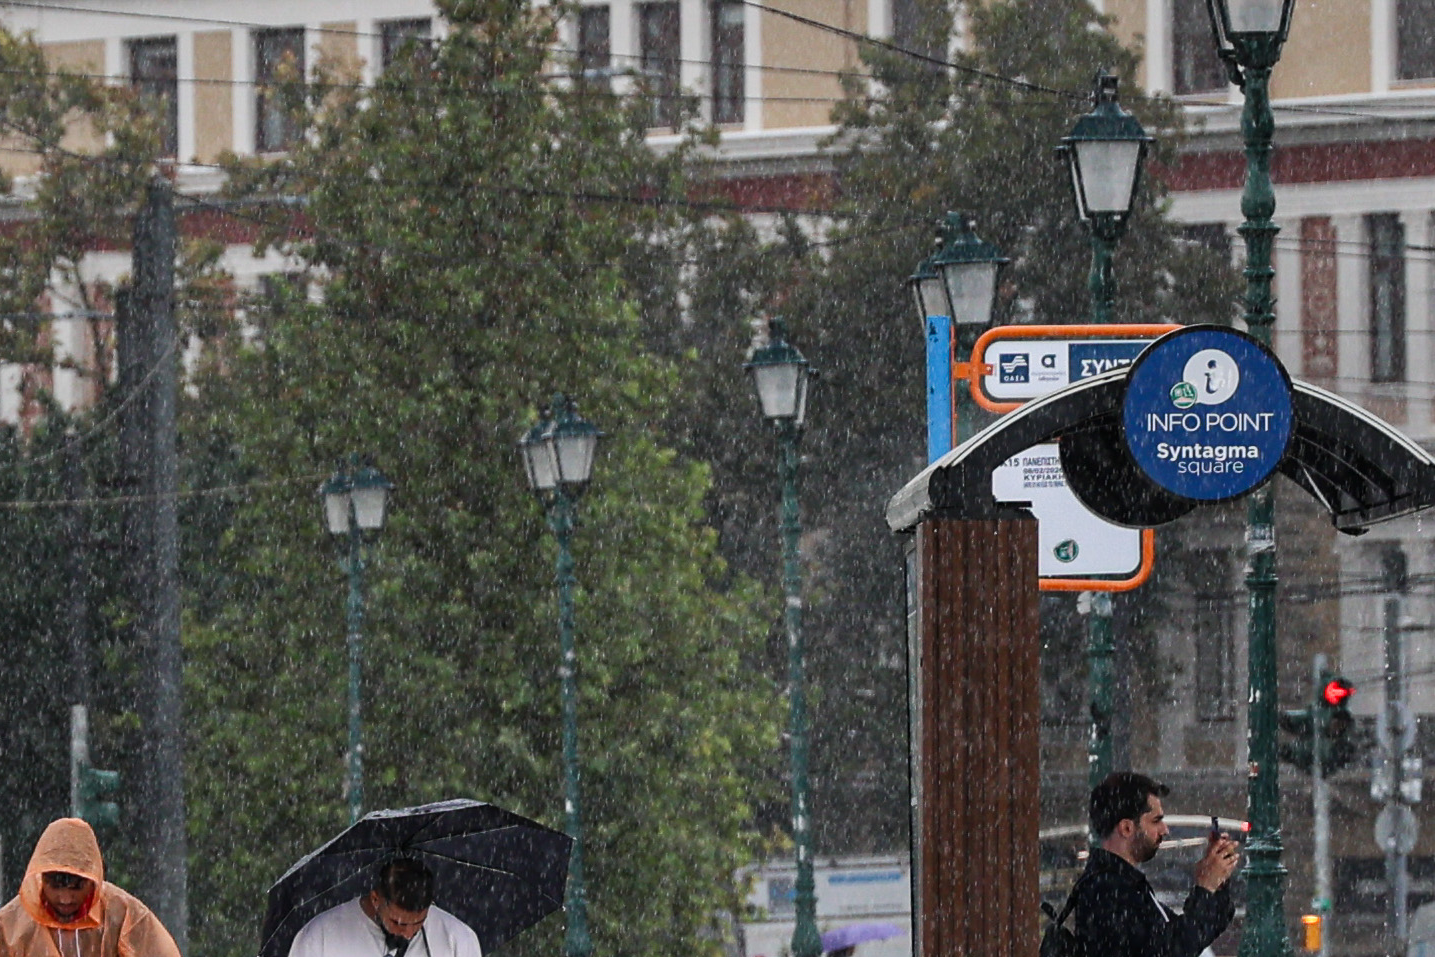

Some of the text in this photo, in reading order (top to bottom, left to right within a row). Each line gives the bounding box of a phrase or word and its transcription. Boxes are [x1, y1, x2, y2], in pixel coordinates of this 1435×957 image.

[1147, 412, 1275, 432] INFO POINT
[1156, 442, 1259, 461] Syntagma
[1178, 460, 1244, 477] square
